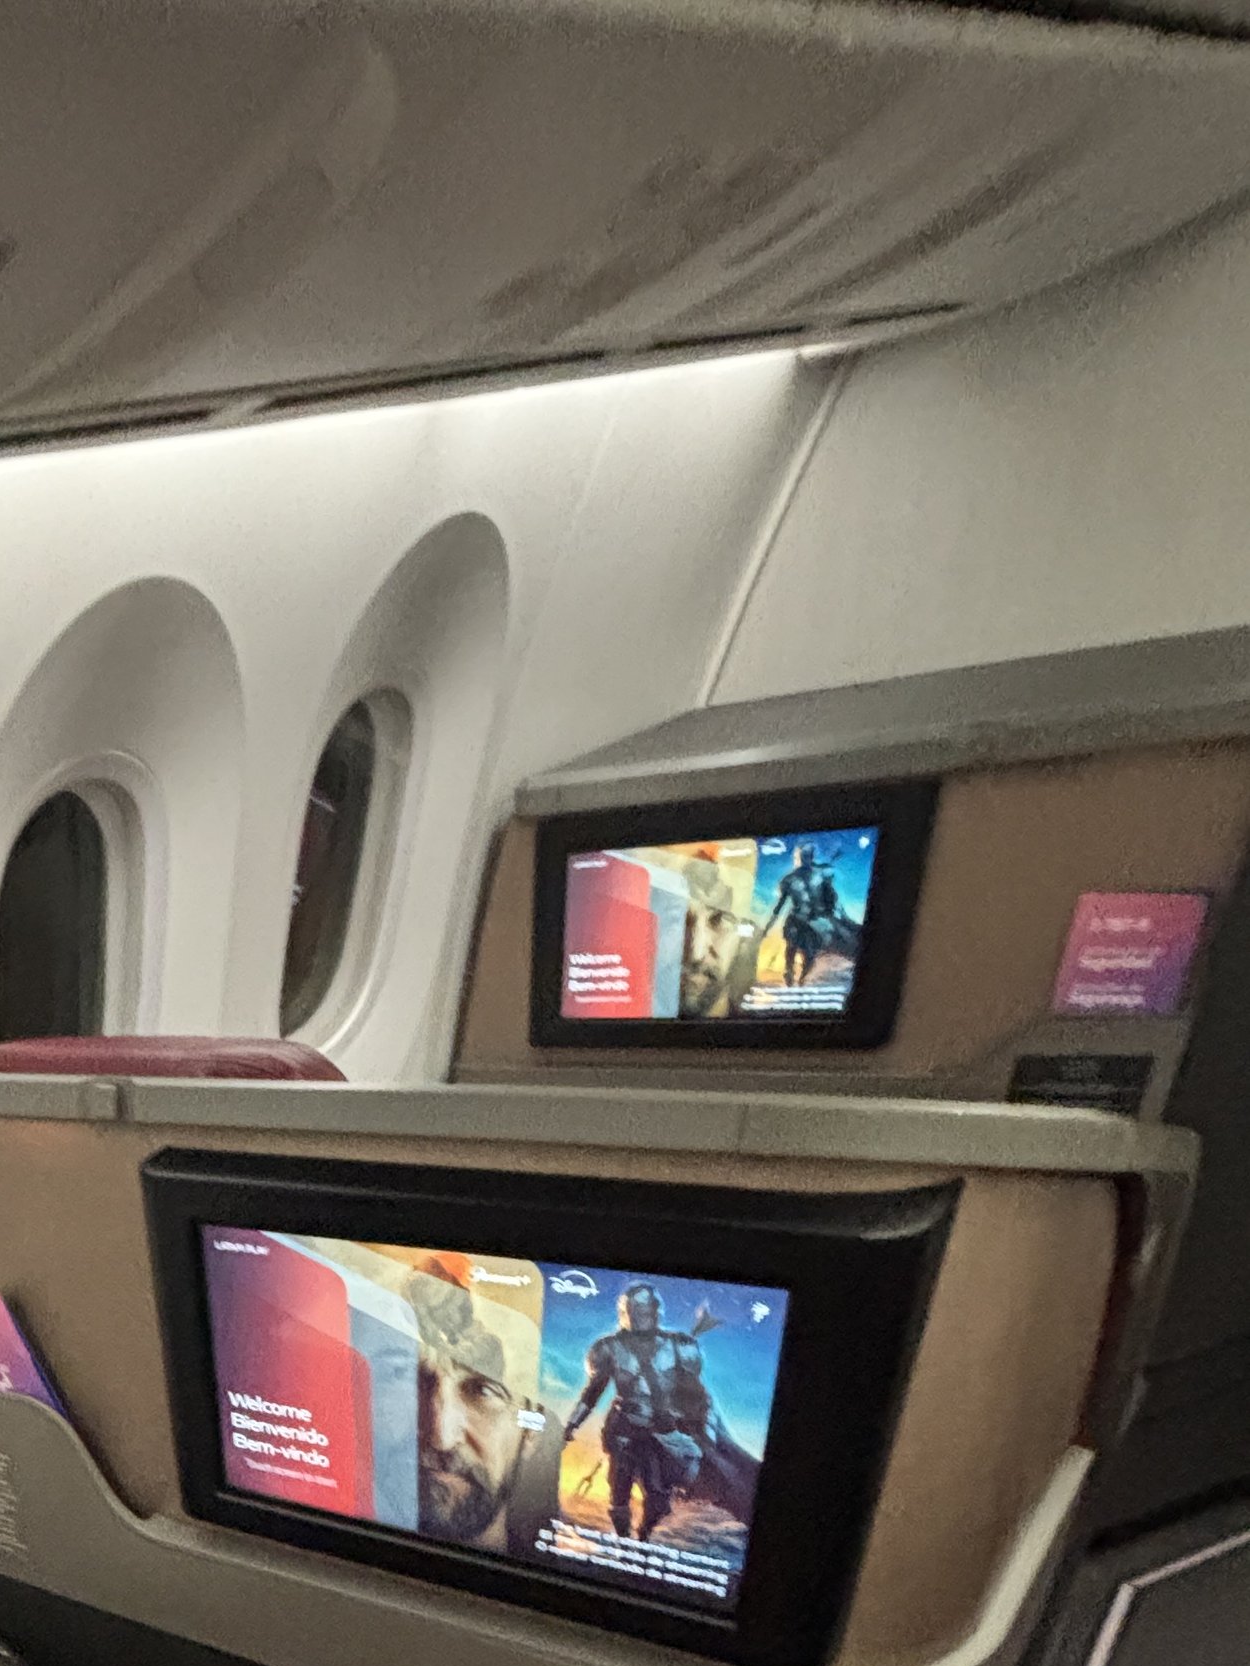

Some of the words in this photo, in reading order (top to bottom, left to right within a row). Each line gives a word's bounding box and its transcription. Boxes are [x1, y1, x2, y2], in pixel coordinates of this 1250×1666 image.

[227, 1391, 312, 1422] Welcome
[230, 1411, 329, 1446] Bienvenido
[232, 1432, 330, 1468] Bem-vindo
